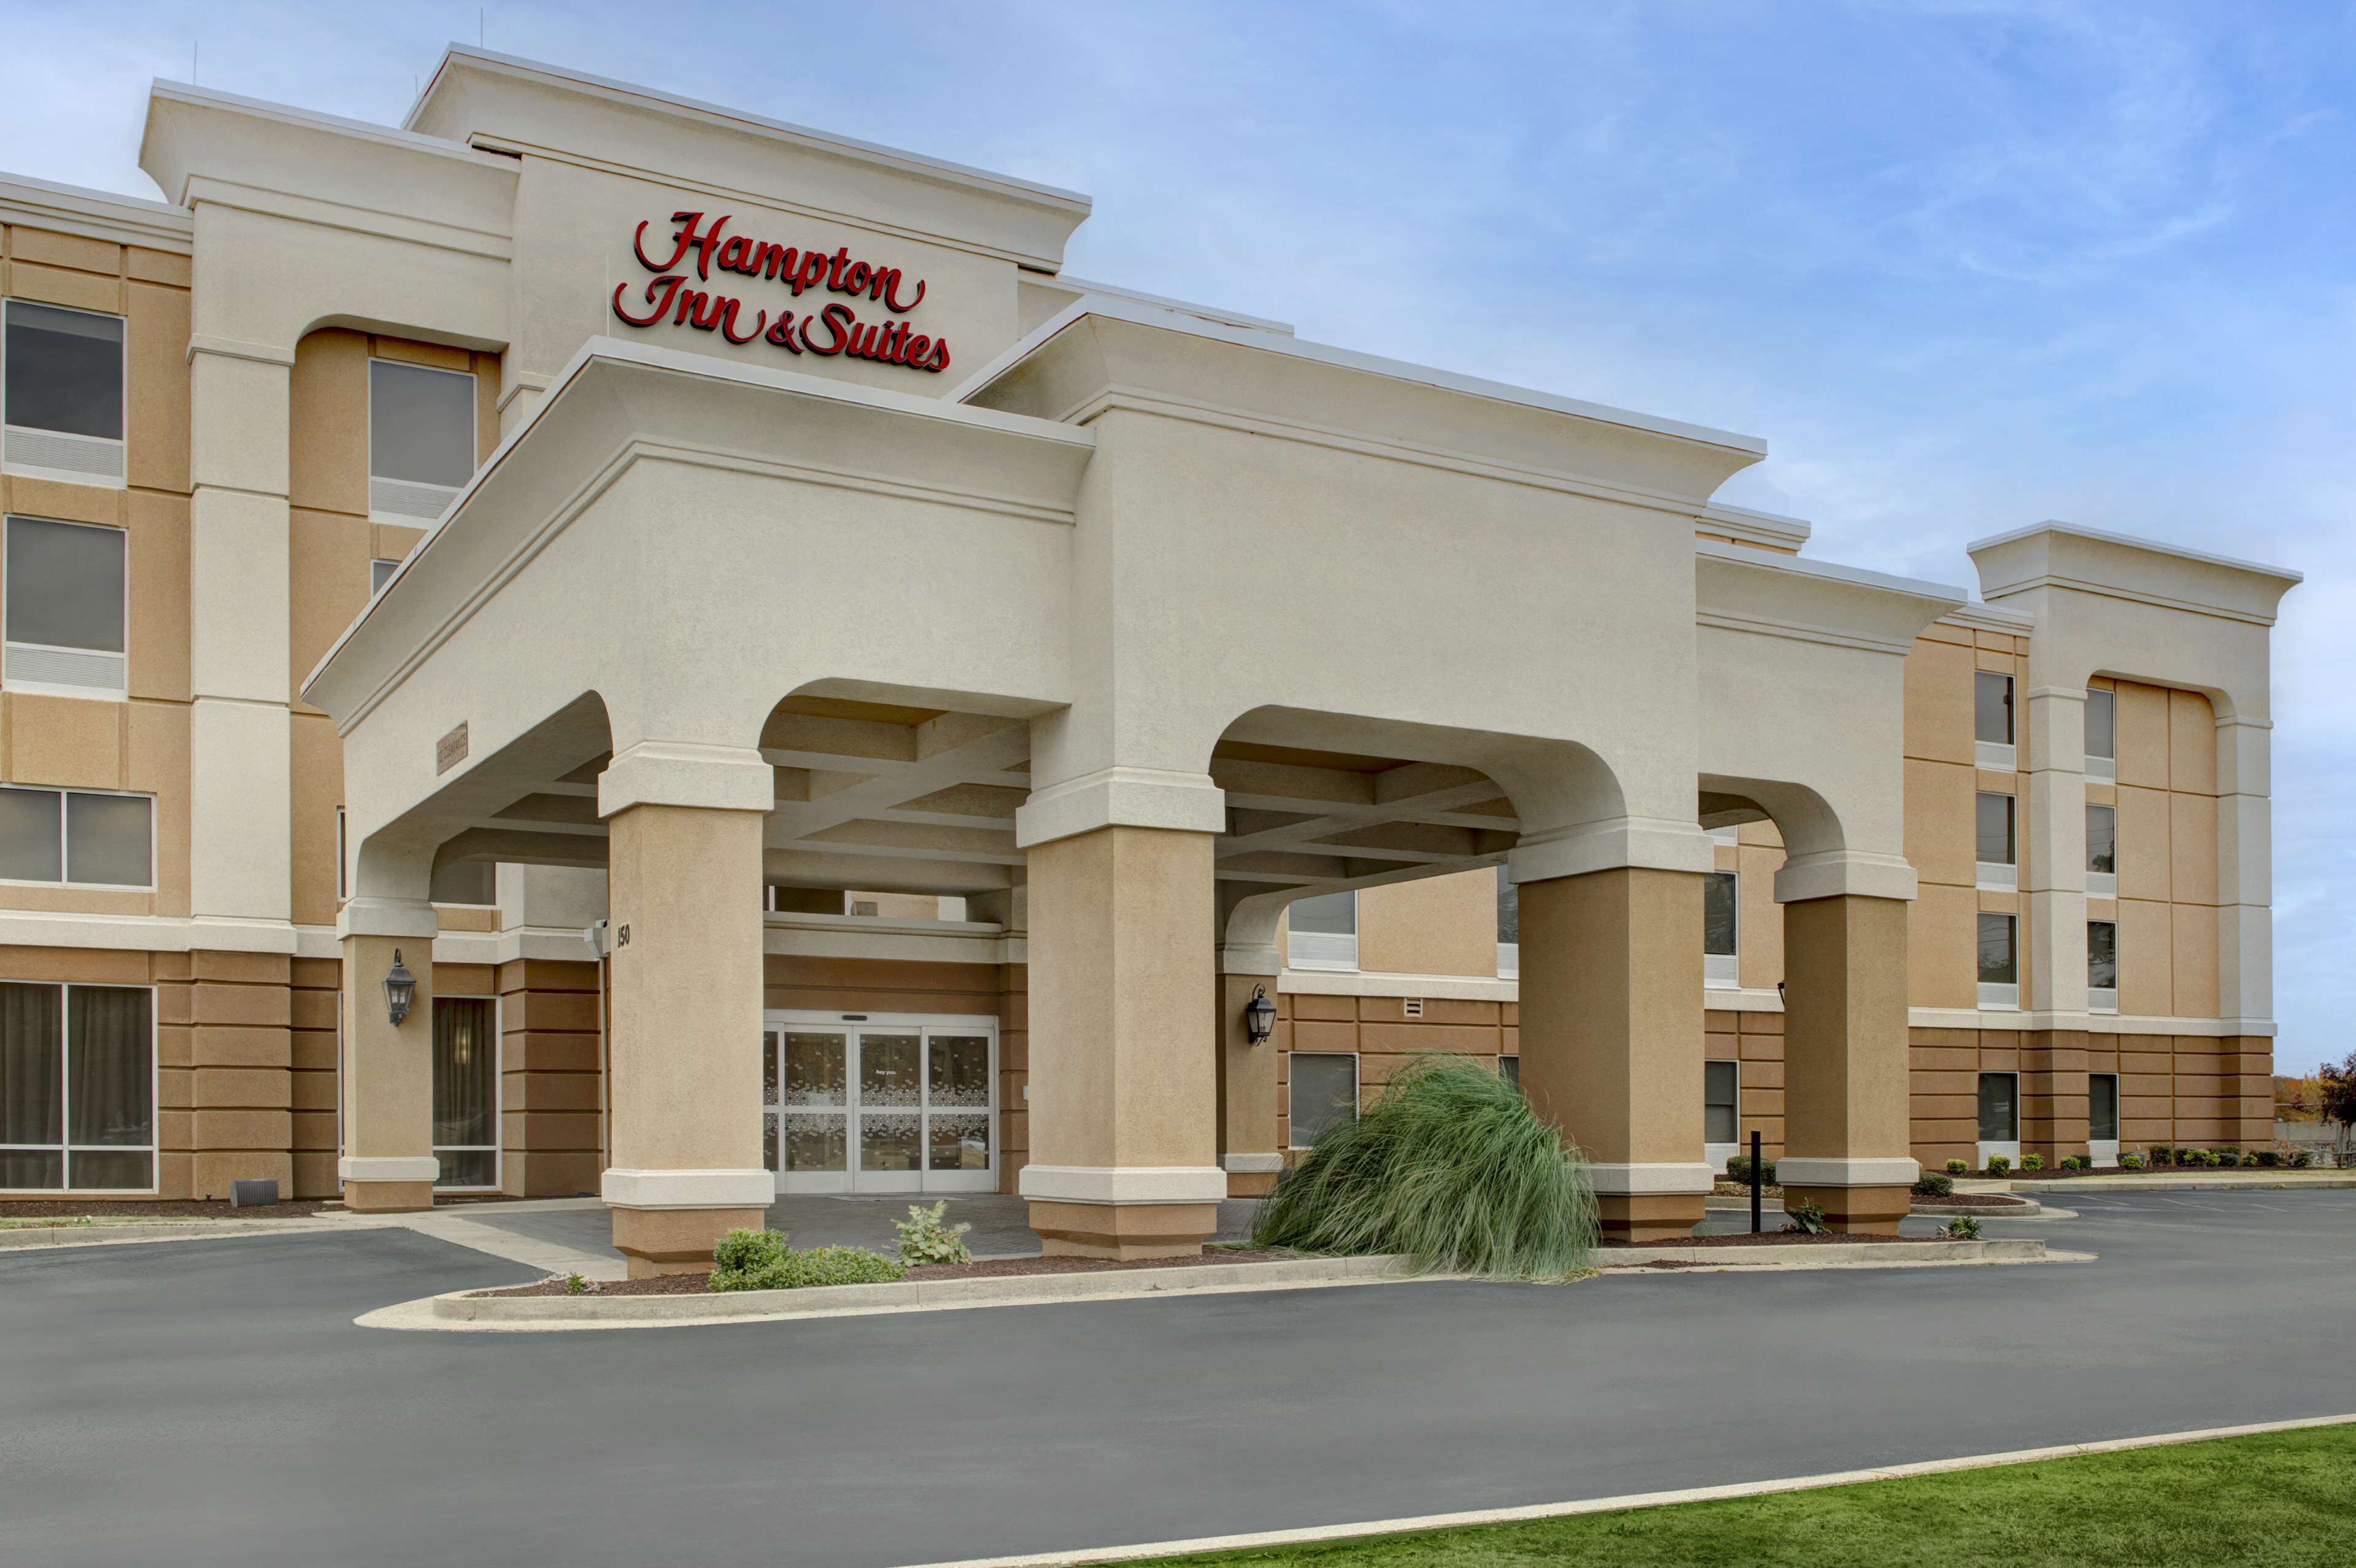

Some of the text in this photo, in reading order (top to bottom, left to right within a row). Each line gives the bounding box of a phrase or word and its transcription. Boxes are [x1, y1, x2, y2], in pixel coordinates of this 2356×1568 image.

[634, 212, 925, 314] Hampton
[612, 276, 951, 373] Inn & Suites
[617, 924, 630, 948] 150
